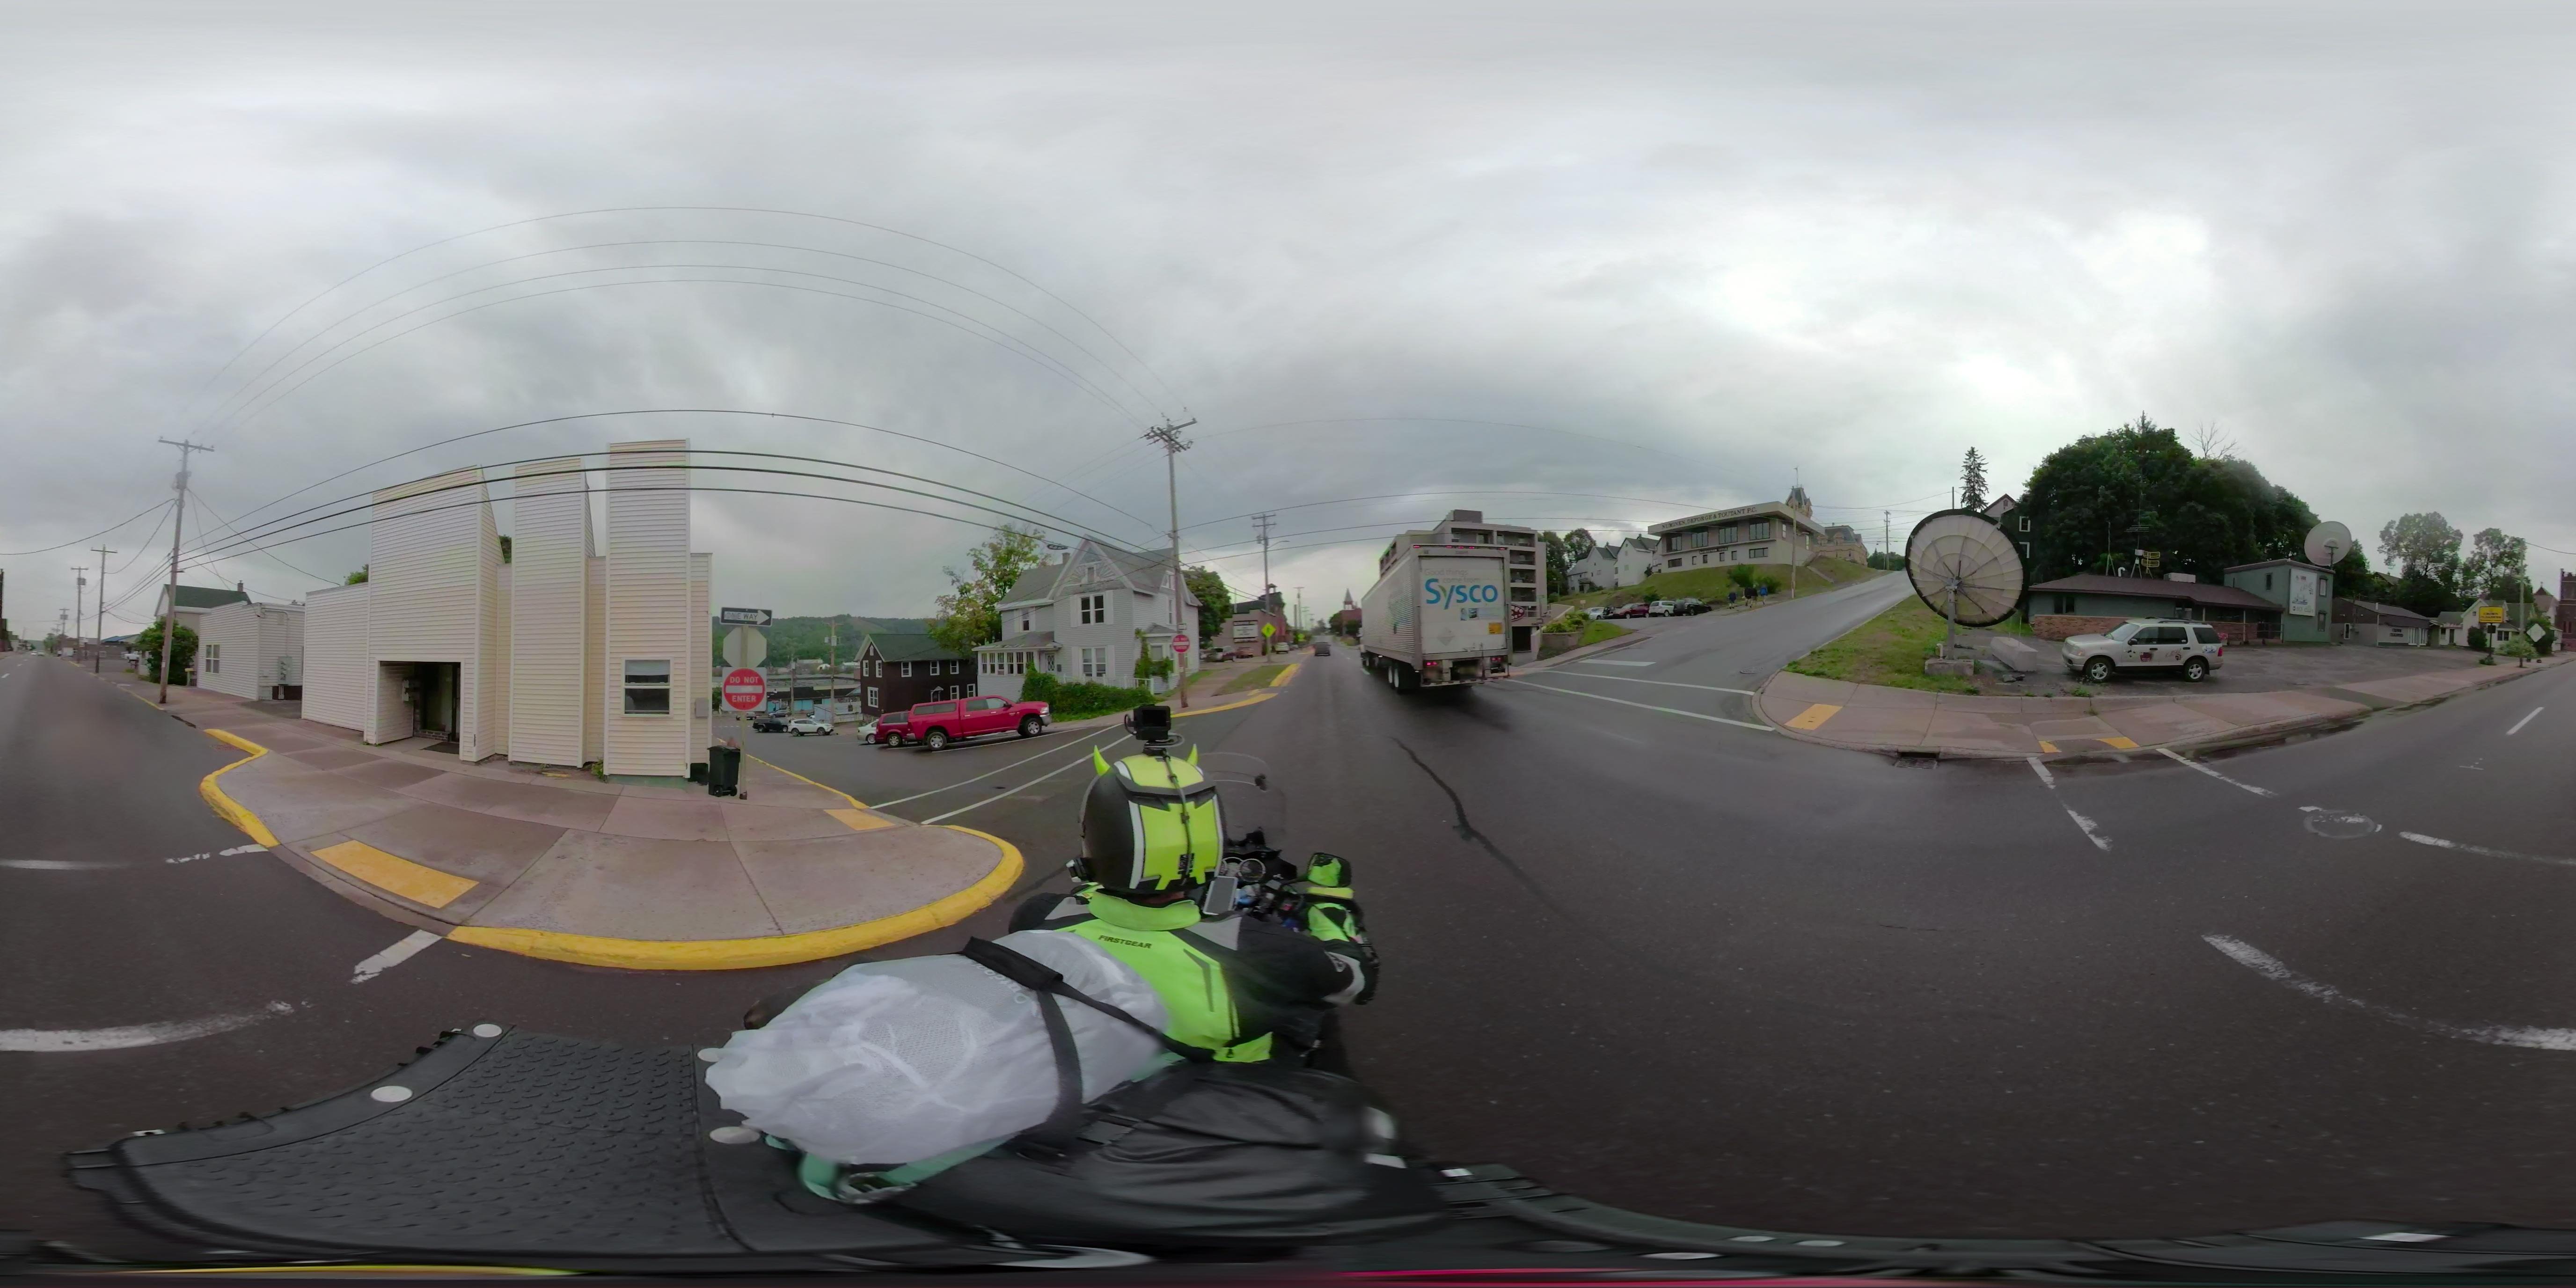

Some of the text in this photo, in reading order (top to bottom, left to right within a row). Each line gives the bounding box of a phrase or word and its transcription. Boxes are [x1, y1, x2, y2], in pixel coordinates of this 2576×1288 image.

[1718, 509, 1745, 518] TOUTANT
[1425, 578, 1498, 609] Sysco
[1098, 935, 1152, 949] FIRSTGEAR
